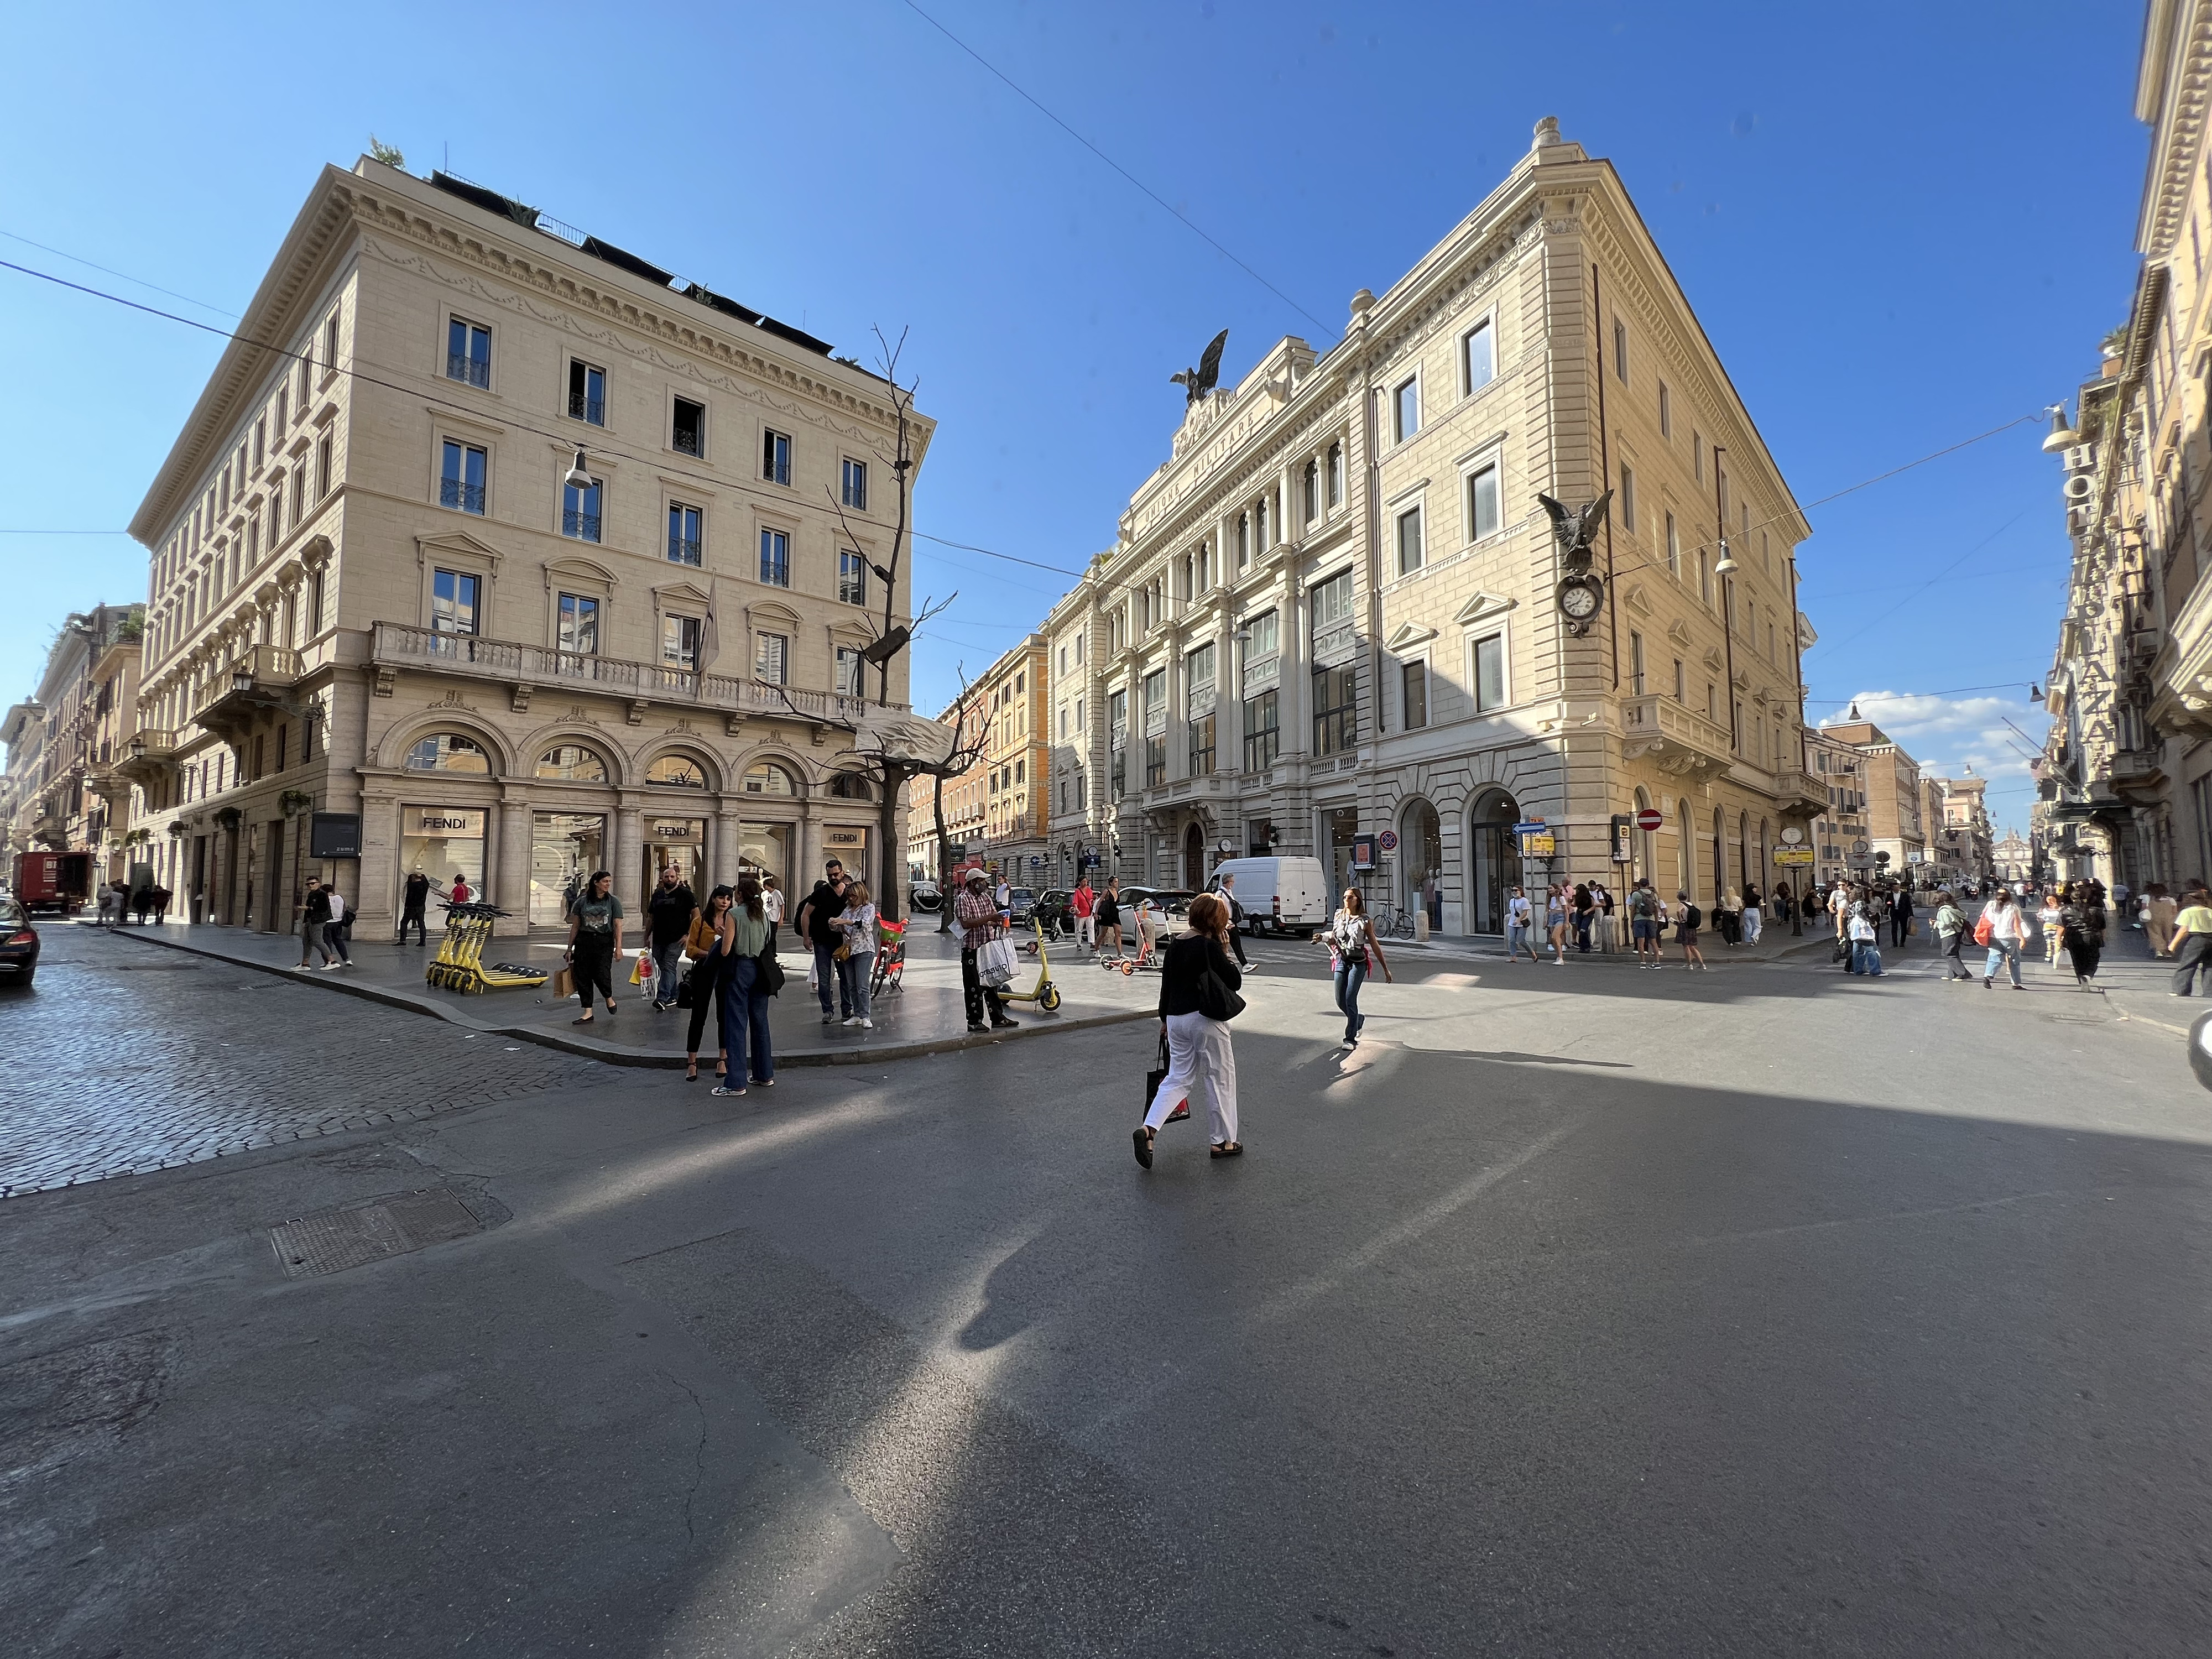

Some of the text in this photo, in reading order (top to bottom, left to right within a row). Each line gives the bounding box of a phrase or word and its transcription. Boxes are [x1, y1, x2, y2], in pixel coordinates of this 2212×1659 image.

[1145, 412, 1254, 522] UNIONE MILITARE
[2060, 442, 2117, 744] HOTEL PLAZA
[423, 817, 466, 829] FENDI
[658, 826, 689, 836] FENDI
[833, 833, 857, 842] FENDI
